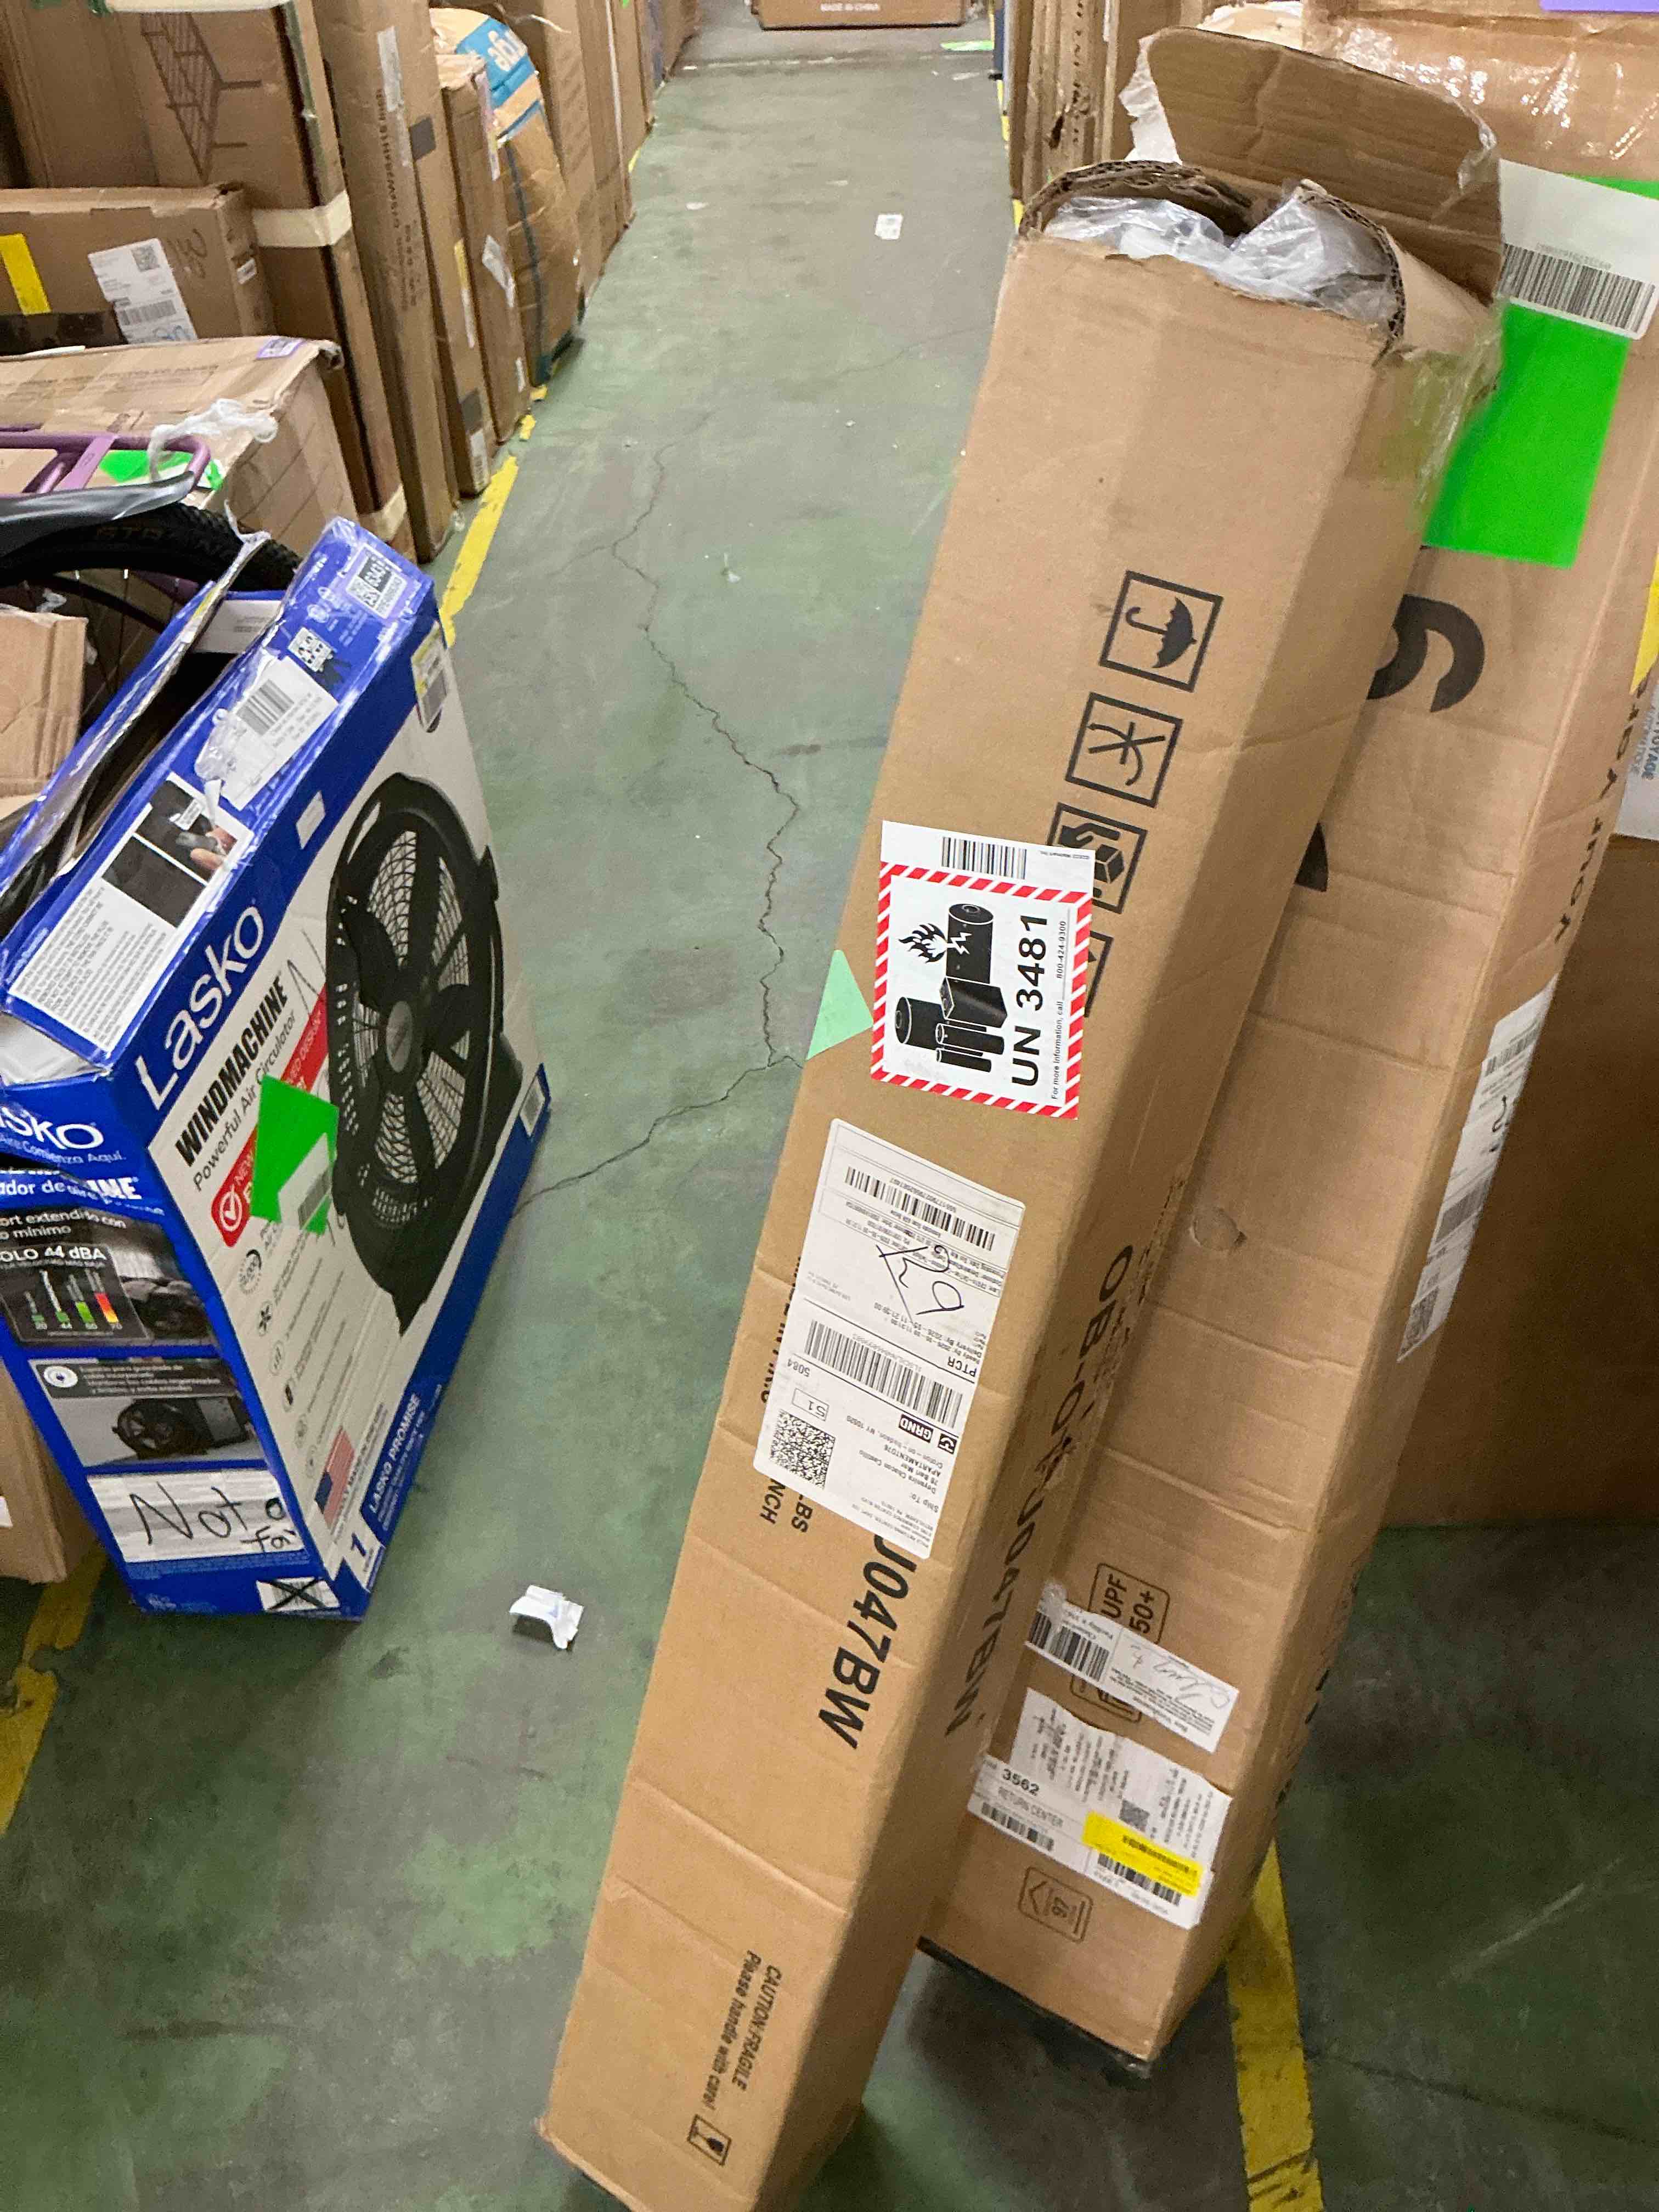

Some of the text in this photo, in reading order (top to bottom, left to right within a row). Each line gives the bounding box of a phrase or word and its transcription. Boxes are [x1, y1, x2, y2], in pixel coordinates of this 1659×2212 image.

[1055, 920, 1067, 979] 800-424-9300
[134, 906, 264, 1111] Lasko
[1012, 915, 1048, 1086] UN 3481
[1054, 1000, 1064, 1015] call
[175, 975, 290, 1167] WINDMACHINE
[193, 1009, 296, 1192] Powerful Air Circulator
[1051, 1087, 1059, 1099] For
[69, 1246, 107, 1260] dBA
[786, 1357, 810, 1378] 5084
[946, 1355, 977, 1378] PTCR
[899, 1416, 933, 1441] GRND
[129, 1482, 248, 1545] Not
[791, 1494, 814, 1533] BS
[907, 1491, 939, 1514] Ship To:
[351, 1533, 367, 1558] 1
[1101, 1573, 1127, 1618] UPF
[1129, 1590, 1155, 1634] 50+
[1002, 1768, 1040, 1797] 3562
[736, 1950, 761, 1997] Please
[732, 1965, 782, 2092] CAUTION FRAGILE
